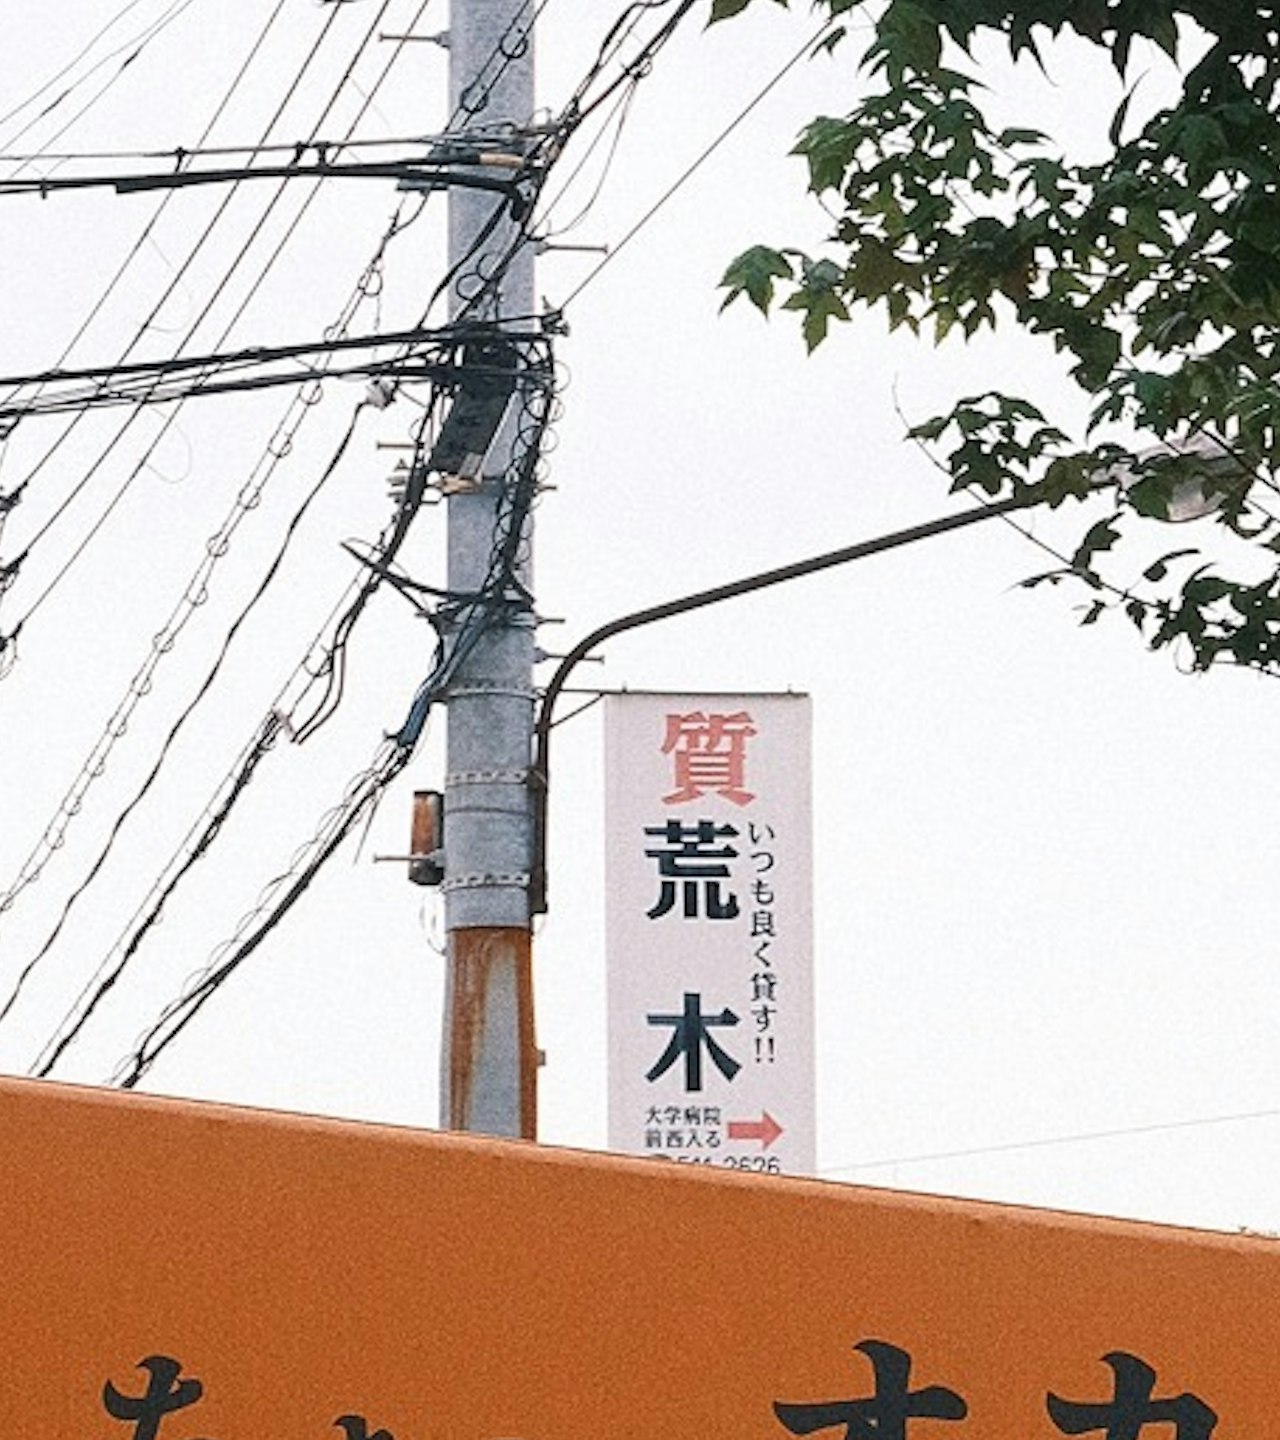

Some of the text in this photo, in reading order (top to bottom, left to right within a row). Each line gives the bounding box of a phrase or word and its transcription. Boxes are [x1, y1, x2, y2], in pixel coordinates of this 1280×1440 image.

[661, 710, 757, 807] 質
[643, 819, 742, 1093] 荒木
[646, 1105, 721, 1126] 大学病院
[646, 1130, 721, 1148] 前西入る
